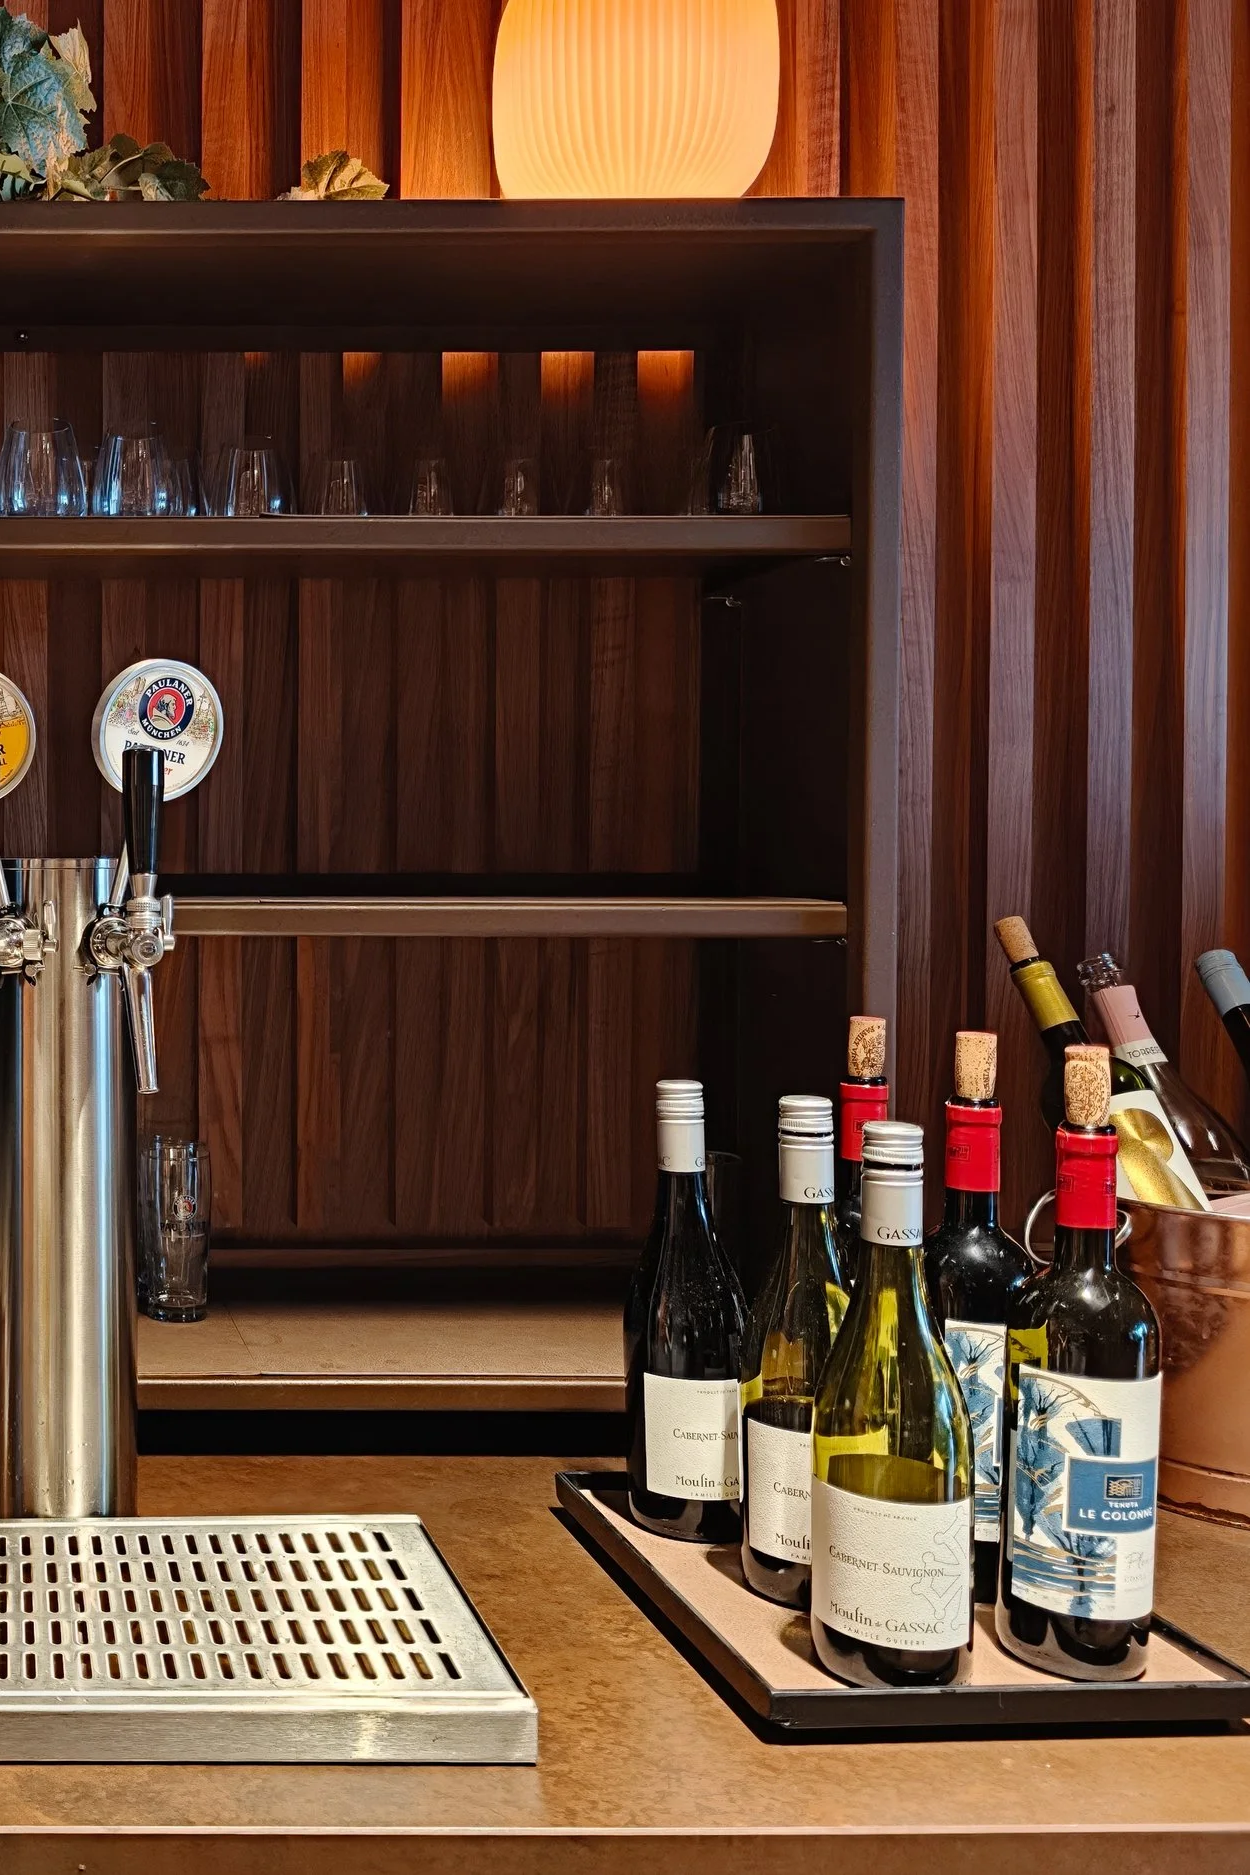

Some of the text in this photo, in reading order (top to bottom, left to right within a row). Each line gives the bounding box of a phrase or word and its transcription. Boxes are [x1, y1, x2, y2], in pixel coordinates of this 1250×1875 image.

[145, 679, 193, 706] PAULANER
[141, 718, 183, 739] MÜNCHEN
[675, 1473, 715, 1488] Moulin
[1109, 1501, 1138, 1509] TENUTA
[1079, 1507, 1153, 1522] LE COLONNE
[776, 1533, 810, 1550] Mouli
[830, 1600, 872, 1627] Moulin
[885, 1618, 945, 1635] GASSAC
[886, 1637, 926, 1646] GUIBERT
